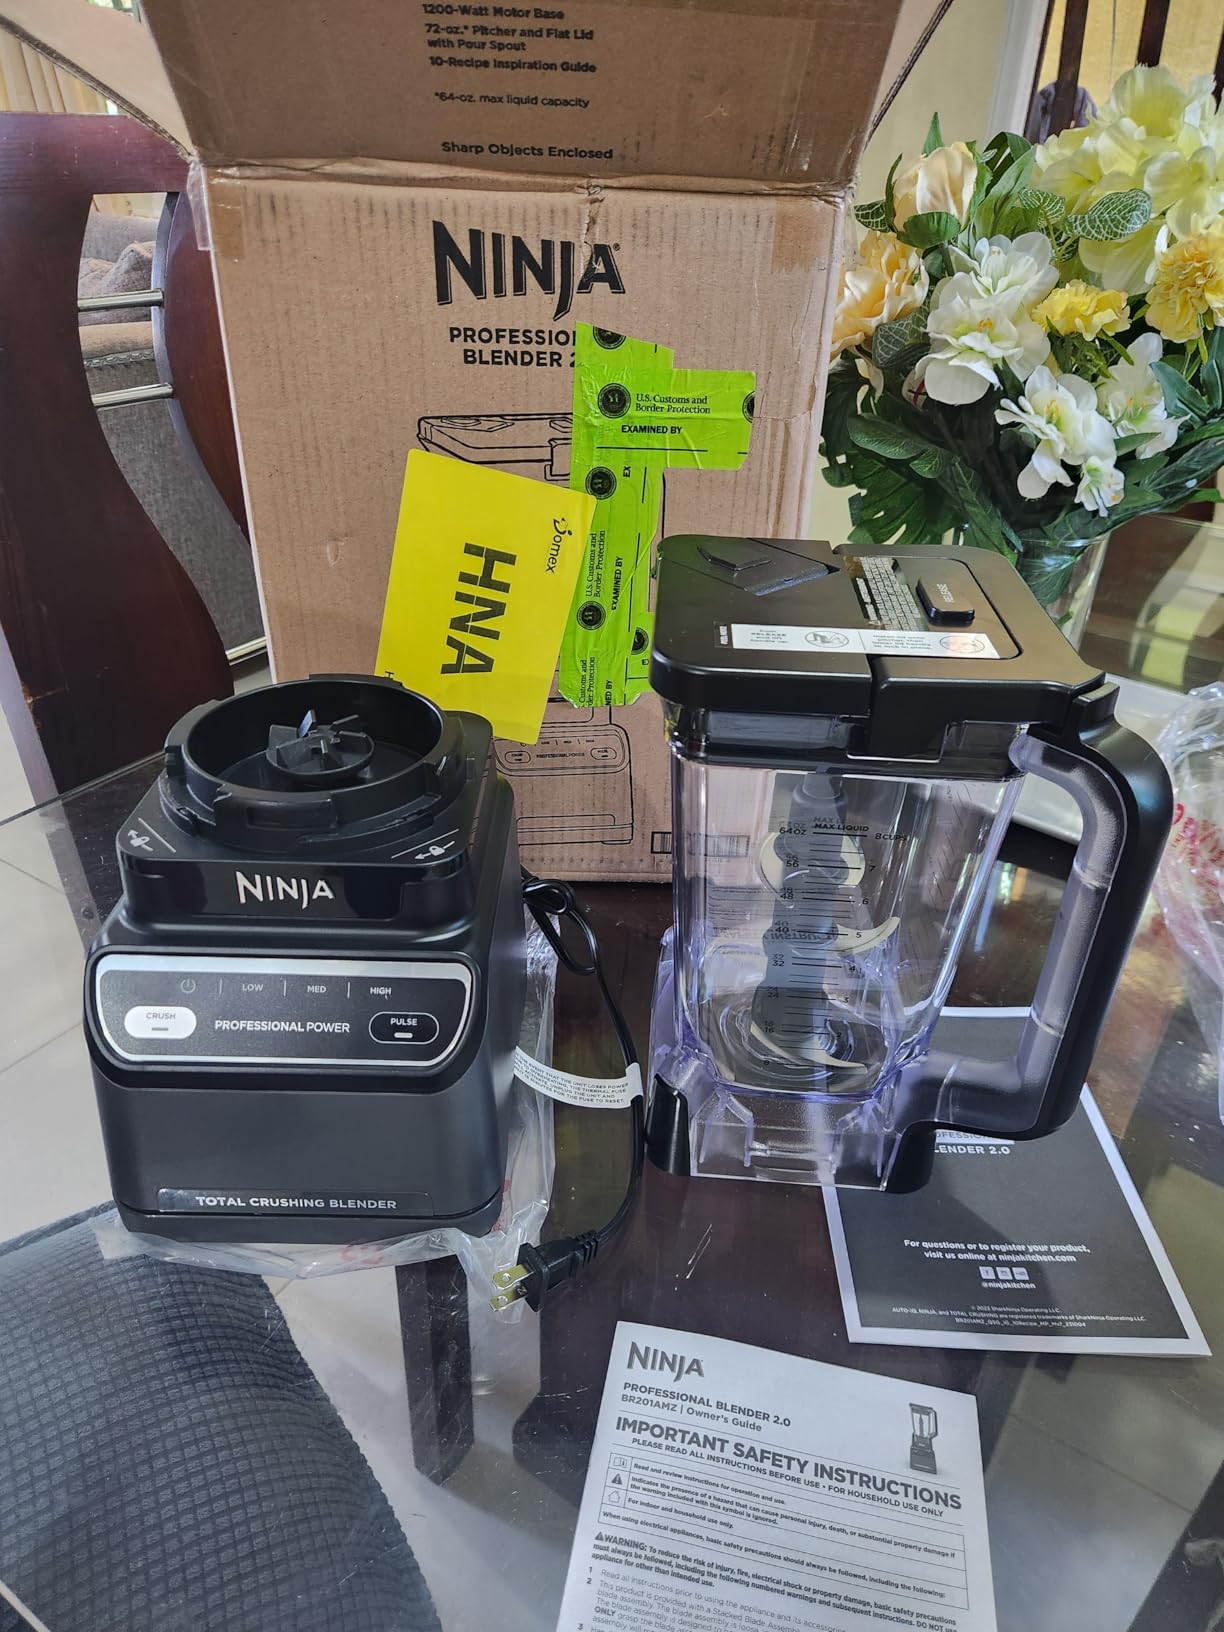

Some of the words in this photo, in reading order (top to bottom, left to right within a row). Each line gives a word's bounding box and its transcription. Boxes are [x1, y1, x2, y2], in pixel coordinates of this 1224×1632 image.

[422, 3, 488, 16] 1200-Watt
[493, 6, 531, 19] Motor
[534, 9, 565, 20] Base
[472, 25, 516, 37] Pitcher
[519, 27, 542, 38] and
[547, 28, 570, 40] Flat
[574, 29, 594, 40] Lid
[427, 38, 454, 48] with
[457, 39, 486, 50] Pour
[489, 41, 526, 52] Spout
[429, 56, 490, 69] 10-Recipe
[493, 58, 557, 71] Inspiration
[560, 61, 596, 73] Guide
[480, 94, 503, 103] max
[506, 94, 538, 106] liquid
[541, 96, 589, 109] capacity
[441, 141, 484, 155] Sharp
[488, 144, 544, 158] Objects
[548, 146, 614, 160] Enclosed
[463, 348, 562, 367] BLENDER
[636, 393, 651, 402] U.S.
[653, 395, 689, 404] Customs
[692, 396, 708, 404] and
[635, 403, 664, 412] Border
[667, 405, 710, 414] Protection
[621, 425, 668, 434] EXAMINED
[670, 426, 682, 435] BY
[596, 530, 605, 570] Protection
[586, 549, 596, 582] Customs
[615, 556, 623, 567] BY
[594, 571, 603, 597] Border
[611, 569, 622, 610] EXAMINED
[440, 542, 517, 674] HNA
[605, 680, 613, 689] BY
[838, 824, 869, 832] LIQUID
[786, 860, 799, 868] 56
[234, 871, 335, 910] NINJA
[242, 983, 263, 992] LOW
[307, 984, 326, 994] MED
[370, 986, 392, 996] HIGH
[145, 1011, 176, 1021] CRUSH
[390, 1017, 418, 1027] PULSE
[215, 1019, 305, 1032] PROFESSIONAL
[306, 1022, 350, 1033] POWER
[989, 1145, 1010, 1154] 2.0
[196, 1196, 246, 1206] TOTAL
[249, 1197, 325, 1208] CRUSHING
[329, 1199, 396, 1209] BLENDER
[904, 1239, 920, 1248] For
[922, 1241, 966, 1250] questions
[990, 1243, 1026, 1252] register
[1027, 1244, 1048, 1253] your
[1050, 1244, 1091, 1253] product,
[924, 1251, 943, 1259] visit
[958, 1252, 986, 1261] online
[998, 1254, 1077, 1263] ninjakitchen.com
[981, 1281, 1036, 1289] @ninjakitchen
[626, 1341, 705, 1382] NINJA
[621, 1394, 677, 1412] BR201AMZ
[686, 1407, 728, 1424] Owner's
[731, 1418, 762, 1431] Guide
[623, 1382, 713, 1407] PROFESSIONAL
[715, 1401, 770, 1421] BLENDER
[772, 1415, 790, 1427] 2.0
[615, 1416, 729, 1453] IMPORTANT
[732, 1442, 808, 1473] SAFETY
[813, 1462, 962, 1510] INSTRUCTIONS
[631, 1437, 663, 1450] PLEASE
[664, 1444, 687, 1455] READ
[689, 1450, 703, 1459] ALL
[706, 1454, 767, 1475] INSTRUCTIONS
[768, 1471, 801, 1483] BEFORE
[803, 1478, 820, 1488] USE
[828, 1484, 845, 1494] FOR
[847, 1489, 900, 1507] HOUSEHOLD
[902, 1501, 918, 1511] USE
[920, 1505, 944, 1517] ONLY
[633, 1462, 649, 1471] Read
[649, 1466, 661, 1474] and
[662, 1469, 682, 1479] review
[683, 1475, 719, 1487] instructions
[730, 1487, 760, 1498] operation
[773, 1497, 786, 1505] use.
[627, 1497, 638, 1505] For
[639, 1500, 660, 1510] indoor
[660, 1505, 673, 1513] and
[673, 1509, 706, 1520] household
[719, 1519, 734, 1529] only.
[602, 1510, 620, 1520] When
[621, 1515, 638, 1525] using
[639, 1520, 668, 1530] electrical
[669, 1527, 705, 1540] appliances,
[705, 1536, 722, 1545] basic
[723, 1540, 743, 1551] safety
[744, 1546, 781, 1559] precautions
[783, 1555, 804, 1566] should
[805, 1560, 826, 1572] always
[828, 1565, 836, 1573] be
[838, 1568, 867, 1580] followed,
[869, 1576, 899, 1588] including
[900, 1582, 911, 1591] the
[912, 1585, 945, 1598] following:
[603, 1535, 647, 1550] WARNING:
[657, 1548, 680, 1559] reduce
[681, 1554, 692, 1563] the
[693, 1557, 706, 1566] risk
[707, 1560, 714, 1568] of
[714, 1562, 735, 1575] injury,
[736, 1568, 750, 1578] fire,
[751, 1573, 781, 1584] electrical
[783, 1579, 802, 1590] shock
[812, 1588, 841, 1600] property
[843, 1595, 872, 1607] damage,
[873, 1601, 891, 1611] basic
[893, 1605, 914, 1617] safety
[915, 1611, 956, 1626] precautions
